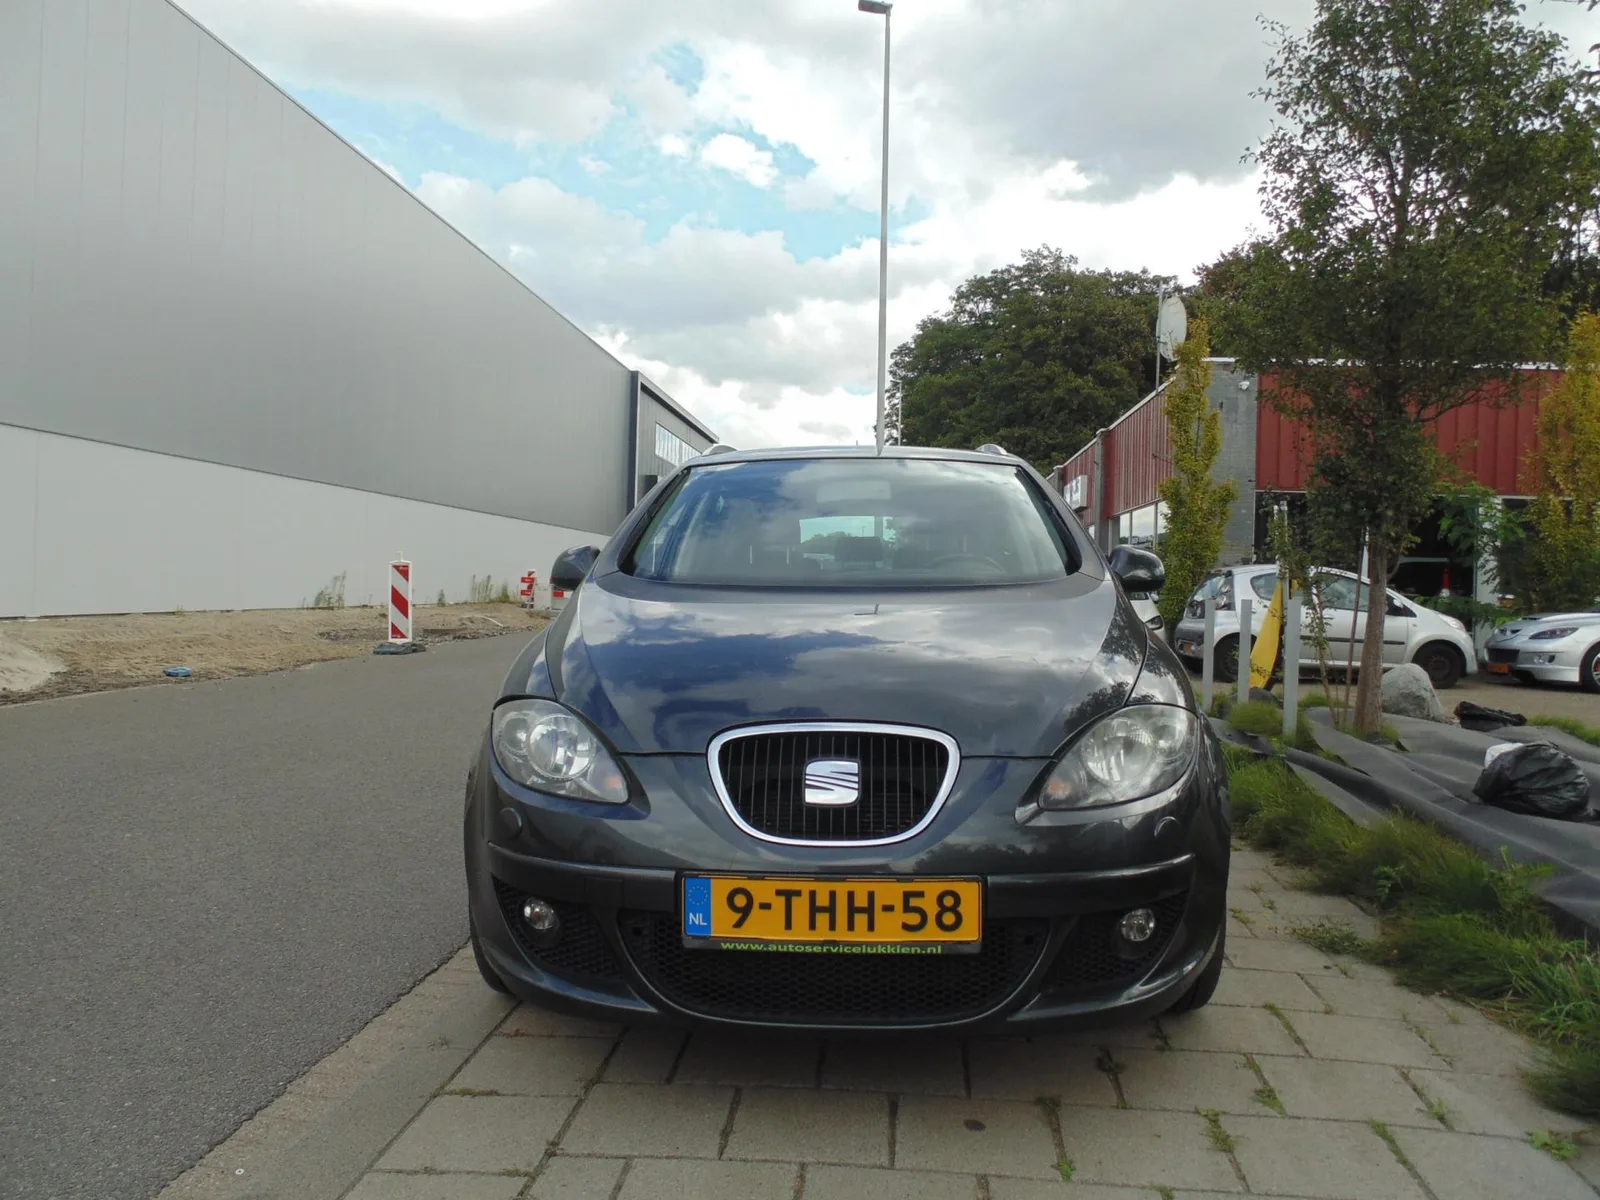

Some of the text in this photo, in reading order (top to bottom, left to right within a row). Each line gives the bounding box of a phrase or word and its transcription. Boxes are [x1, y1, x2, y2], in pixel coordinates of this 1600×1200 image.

[726, 886, 963, 932] 9-THH-58
[688, 913, 708, 926] NL
[720, 941, 942, 955] www.autoservicelukkien.nl
